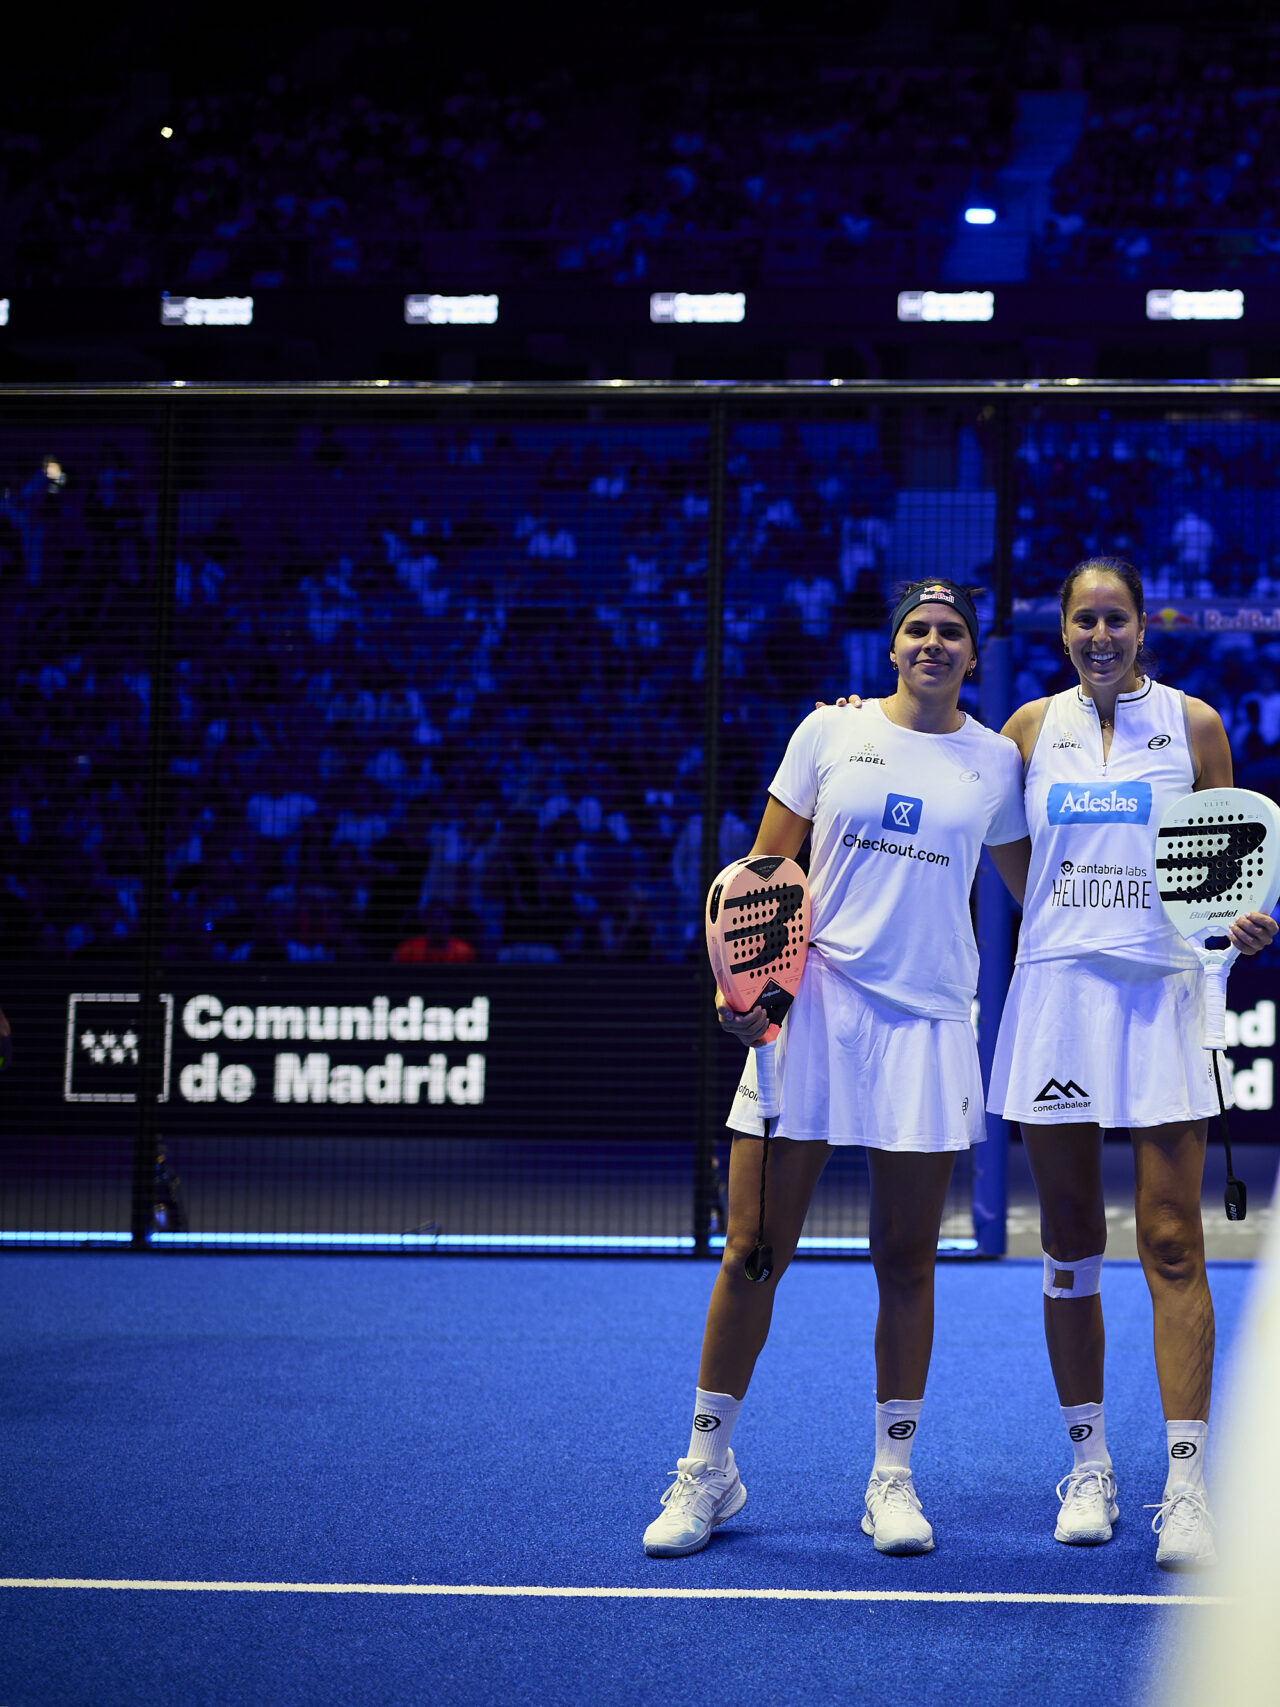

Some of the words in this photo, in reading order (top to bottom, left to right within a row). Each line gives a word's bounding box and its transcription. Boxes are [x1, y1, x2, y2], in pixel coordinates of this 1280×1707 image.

[1204, 608, 1246, 631] Red
[849, 755, 886, 766] PADEL
[1058, 789, 1139, 814] Adeslas
[842, 833, 951, 868] Checkout.com
[1076, 863, 1124, 876] cantabria
[1125, 865, 1148, 878] labs
[1051, 878, 1153, 910] HELIOCARE
[1189, 909, 1239, 921] Bullpadel
[182, 994, 490, 1042] Comunidad
[180, 1052, 256, 1104] de
[274, 1053, 486, 1104] Madrid
[1033, 1100, 1091, 1113] conectabalear
